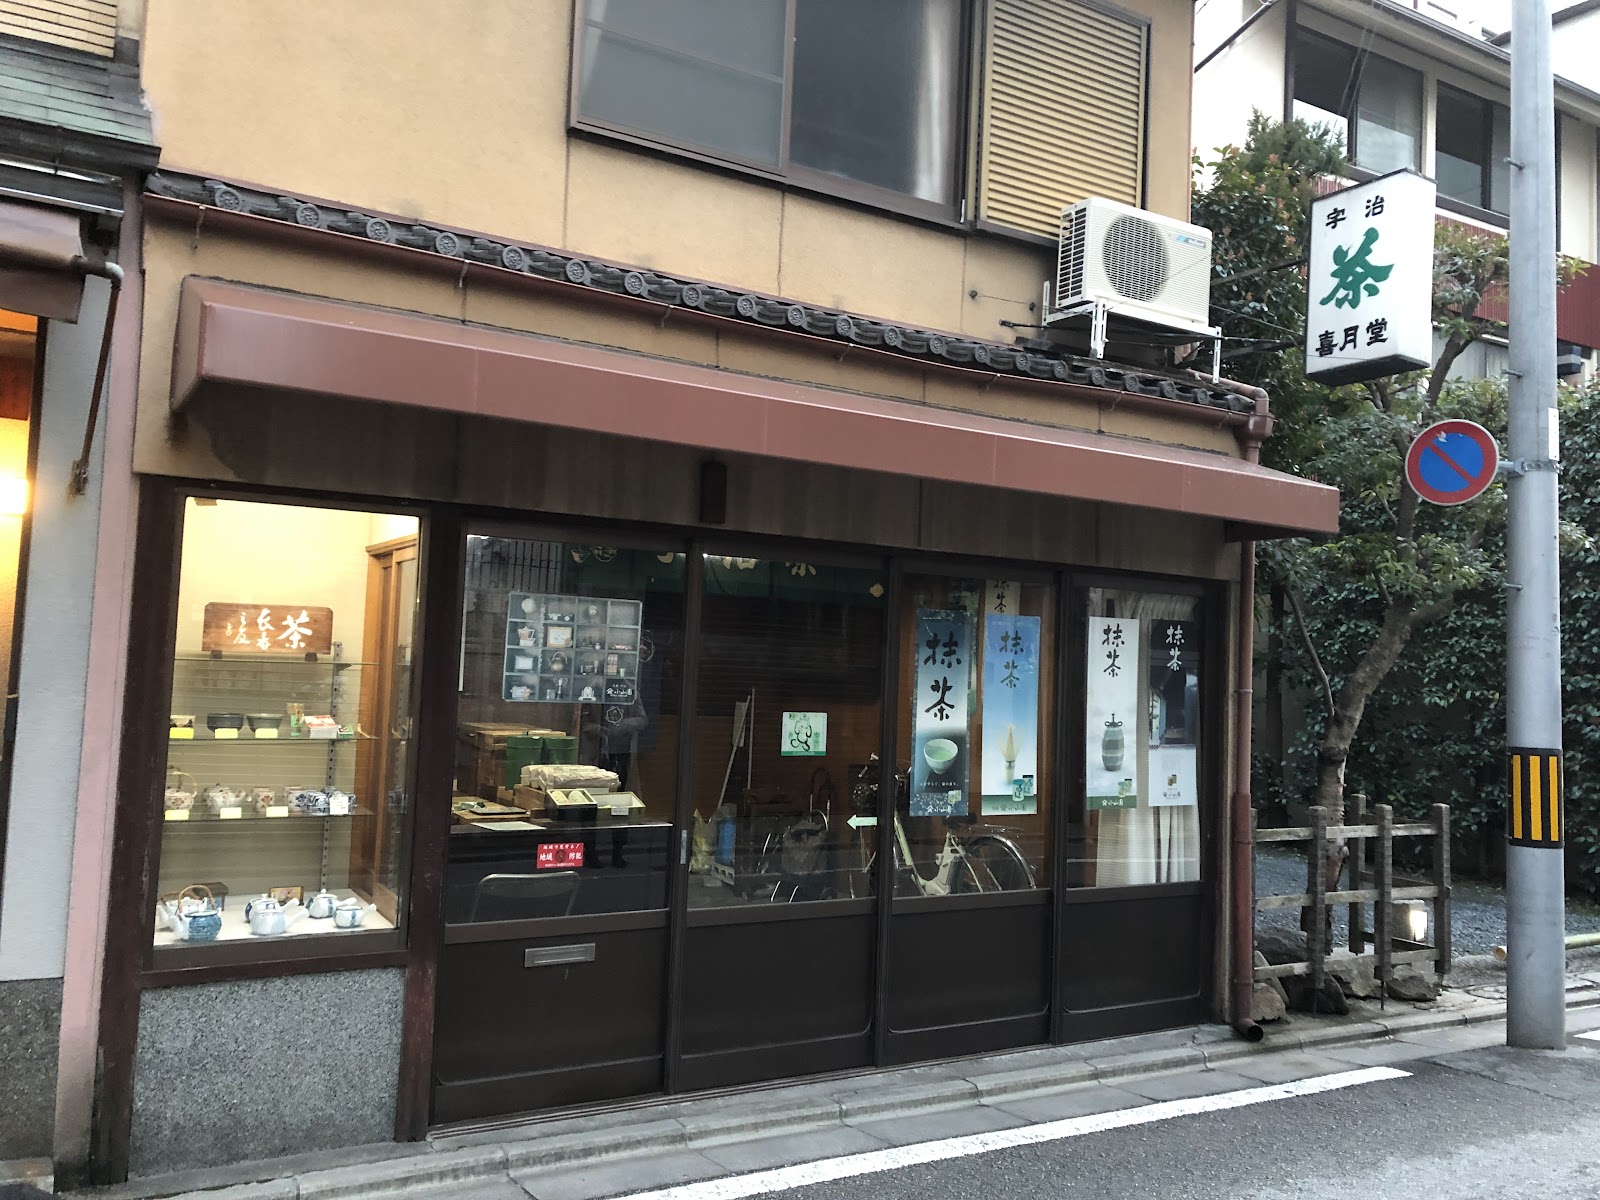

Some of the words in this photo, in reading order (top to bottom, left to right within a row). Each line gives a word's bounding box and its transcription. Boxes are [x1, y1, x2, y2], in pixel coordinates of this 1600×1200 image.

[1325, 195, 1385, 229] 宇治
[1319, 227, 1395, 309] 茶
[1315, 317, 1389, 358] 喜月堂
[276, 609, 313, 650] 茶
[1102, 623, 1125, 678] 抹茶
[1165, 624, 1185, 672] 抹茶
[923, 631, 962, 721] 抹茶
[999, 630, 1024, 689] 抹茶
